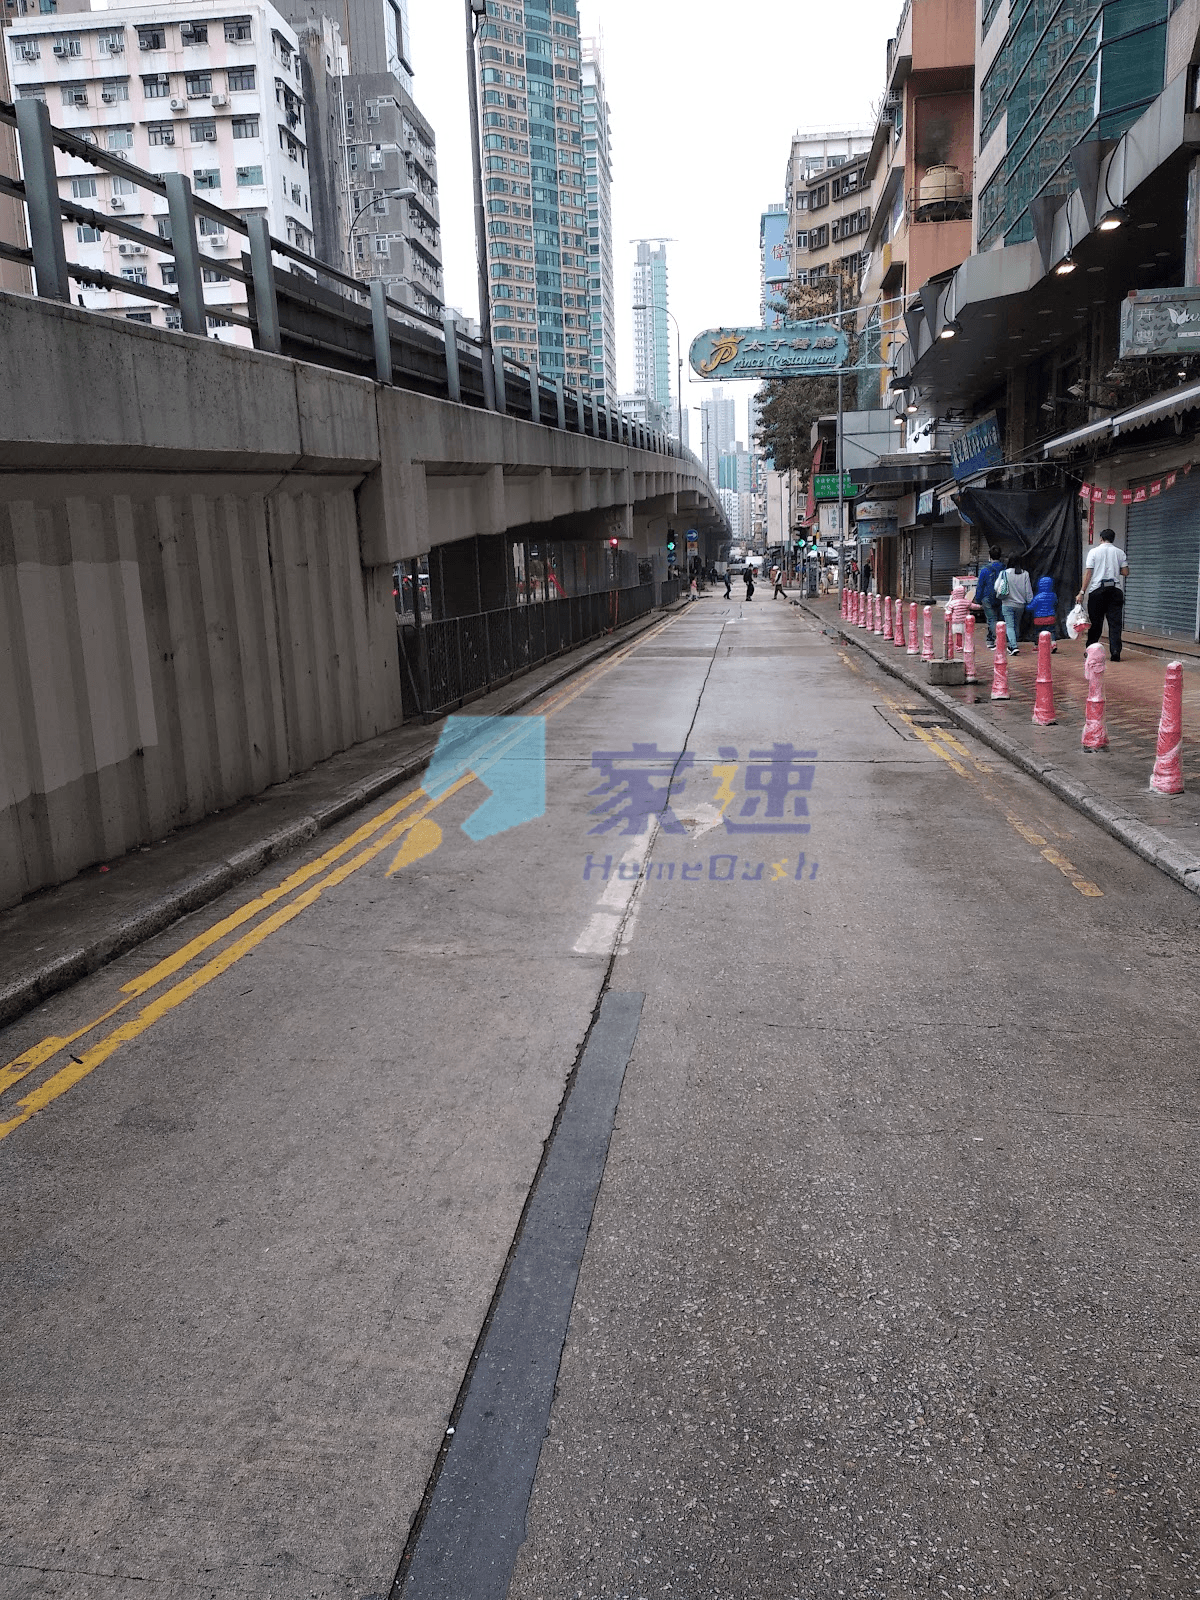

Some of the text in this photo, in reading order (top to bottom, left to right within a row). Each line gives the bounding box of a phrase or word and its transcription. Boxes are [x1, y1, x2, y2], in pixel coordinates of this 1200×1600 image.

[742, 336, 838, 352] 太子餐廳
[700, 341, 837, 372] Prince Restaurant
